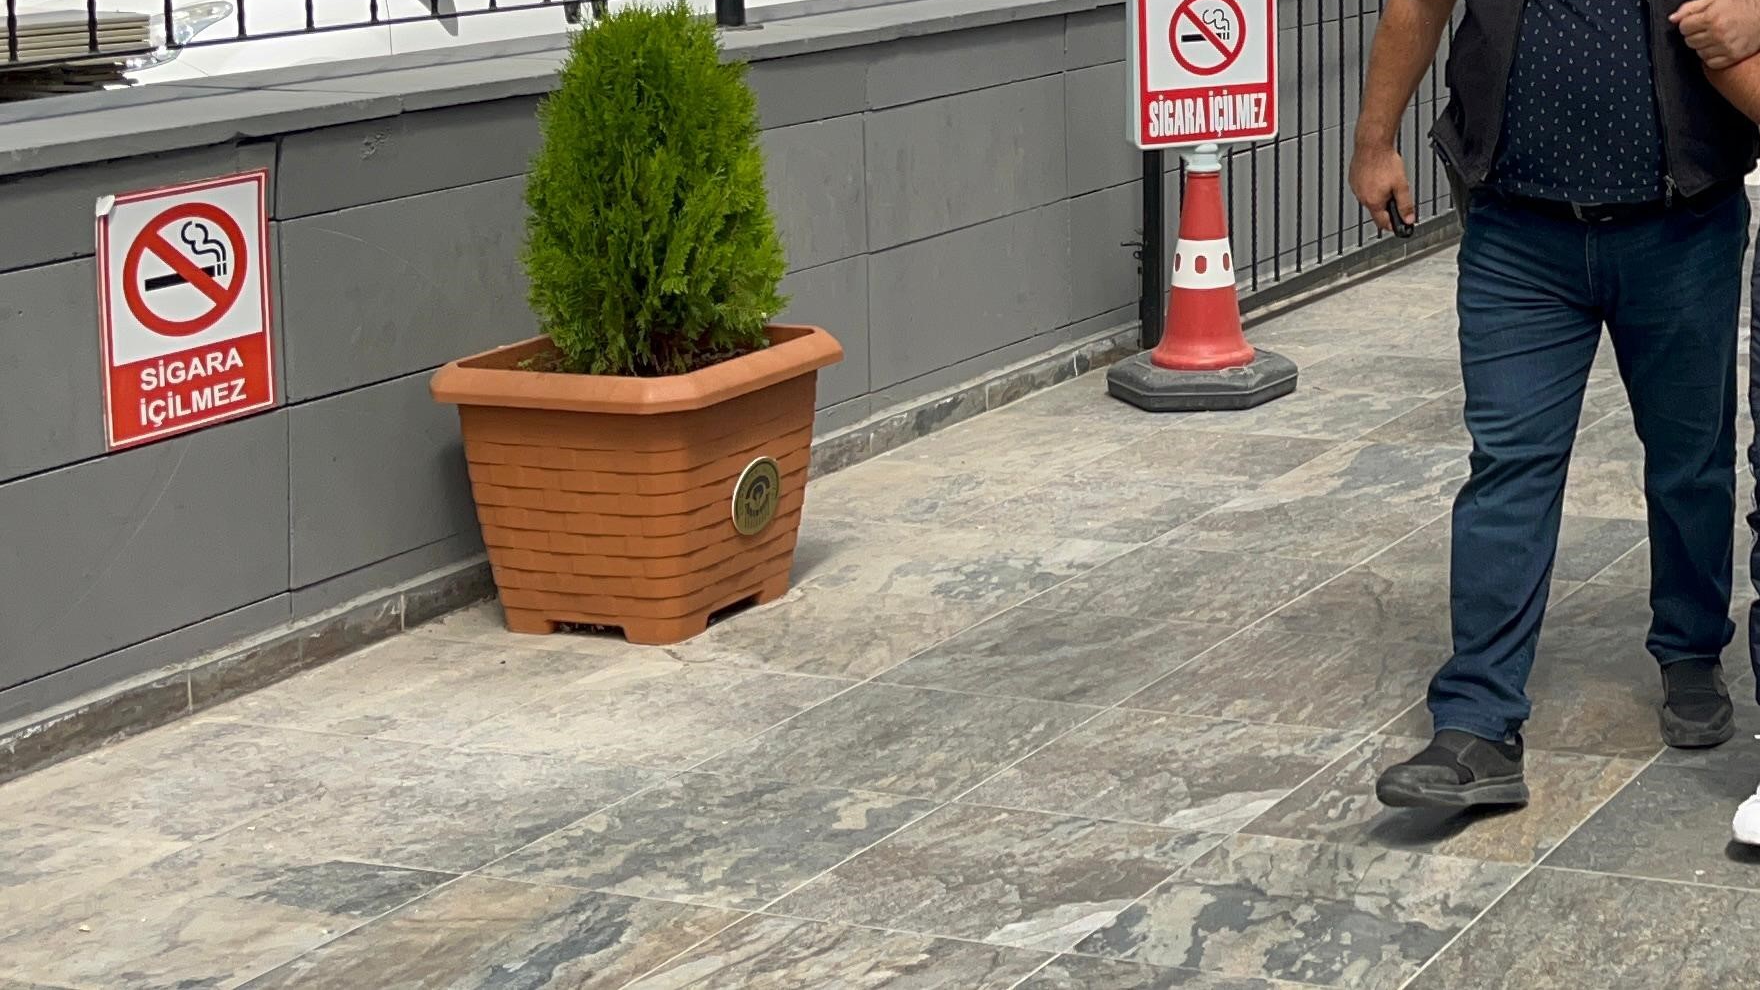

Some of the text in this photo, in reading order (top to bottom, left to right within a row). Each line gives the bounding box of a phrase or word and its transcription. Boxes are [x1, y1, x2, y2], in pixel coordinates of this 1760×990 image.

[1149, 89, 1267, 138] SİGARA İÇİLMEZ
[140, 347, 244, 391] SİGARA
[140, 377, 247, 428] İÇİLMEZ
